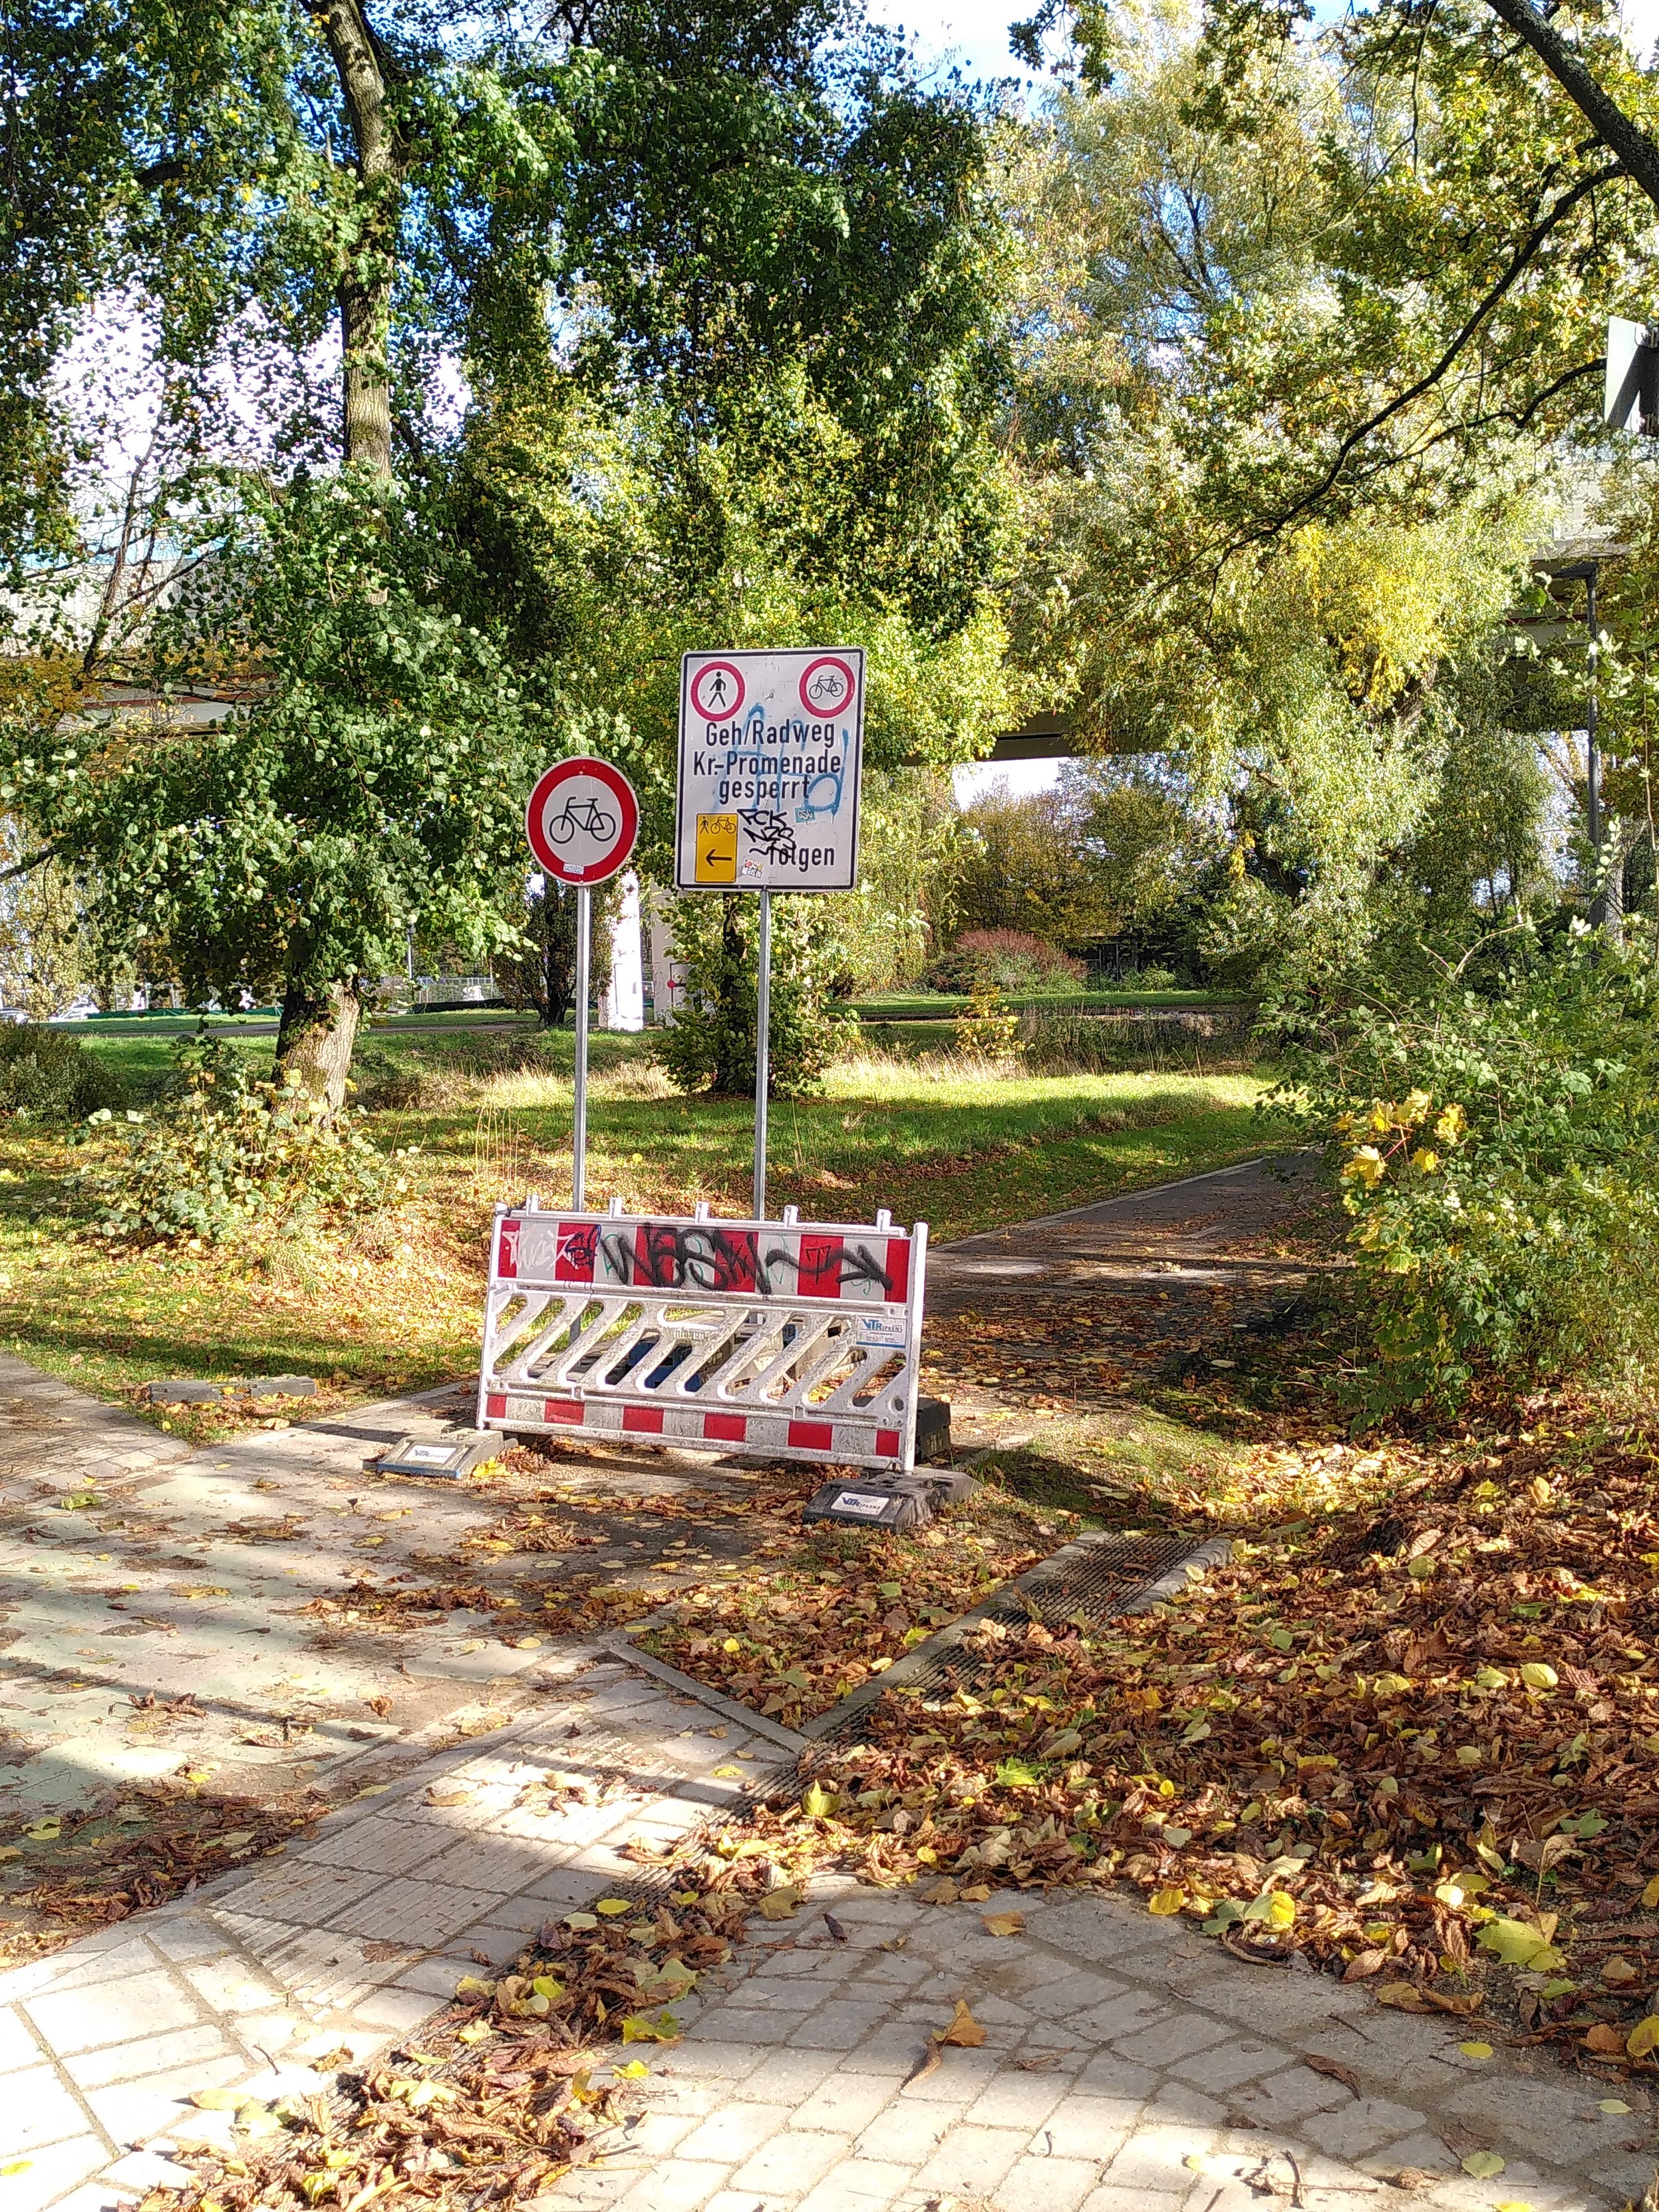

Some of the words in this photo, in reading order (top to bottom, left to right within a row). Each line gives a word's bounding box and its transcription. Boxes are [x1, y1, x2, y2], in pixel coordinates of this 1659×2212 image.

[706, 718, 835, 748] Geh/Radweg
[693, 748, 841, 776] Kr.-Promenade
[719, 774, 810, 806] gesperrt
[736, 808, 788, 827] FCK
[770, 841, 835, 873] folgen
